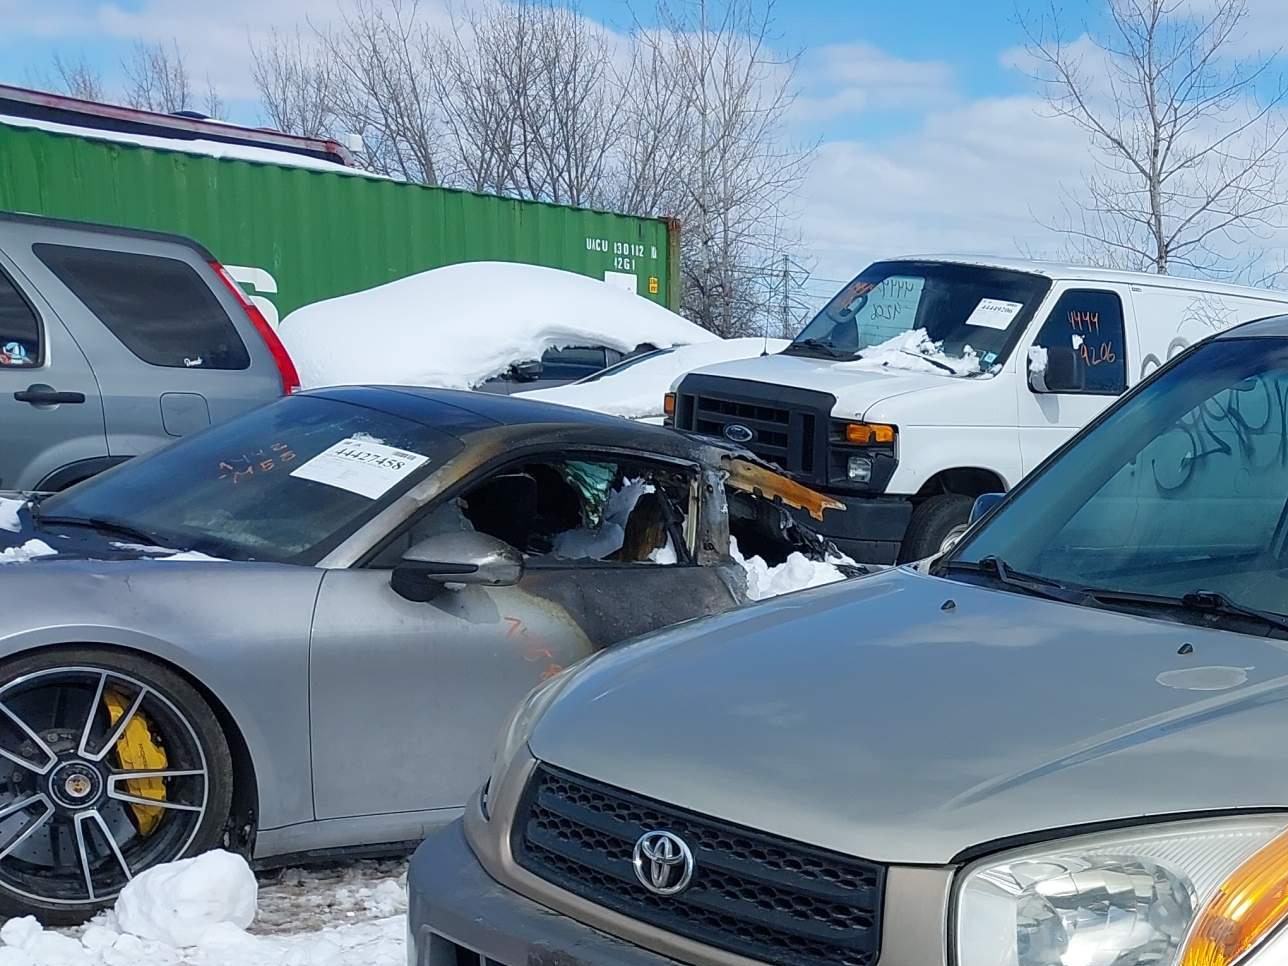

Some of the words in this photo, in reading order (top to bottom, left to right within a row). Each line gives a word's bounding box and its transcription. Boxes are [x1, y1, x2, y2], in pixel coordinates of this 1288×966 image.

[586, 238, 608, 251] UACU
[1067, 311, 1099, 335] 4444
[1080, 342, 1116, 367] 9206
[335, 448, 405, 471] 44427458
